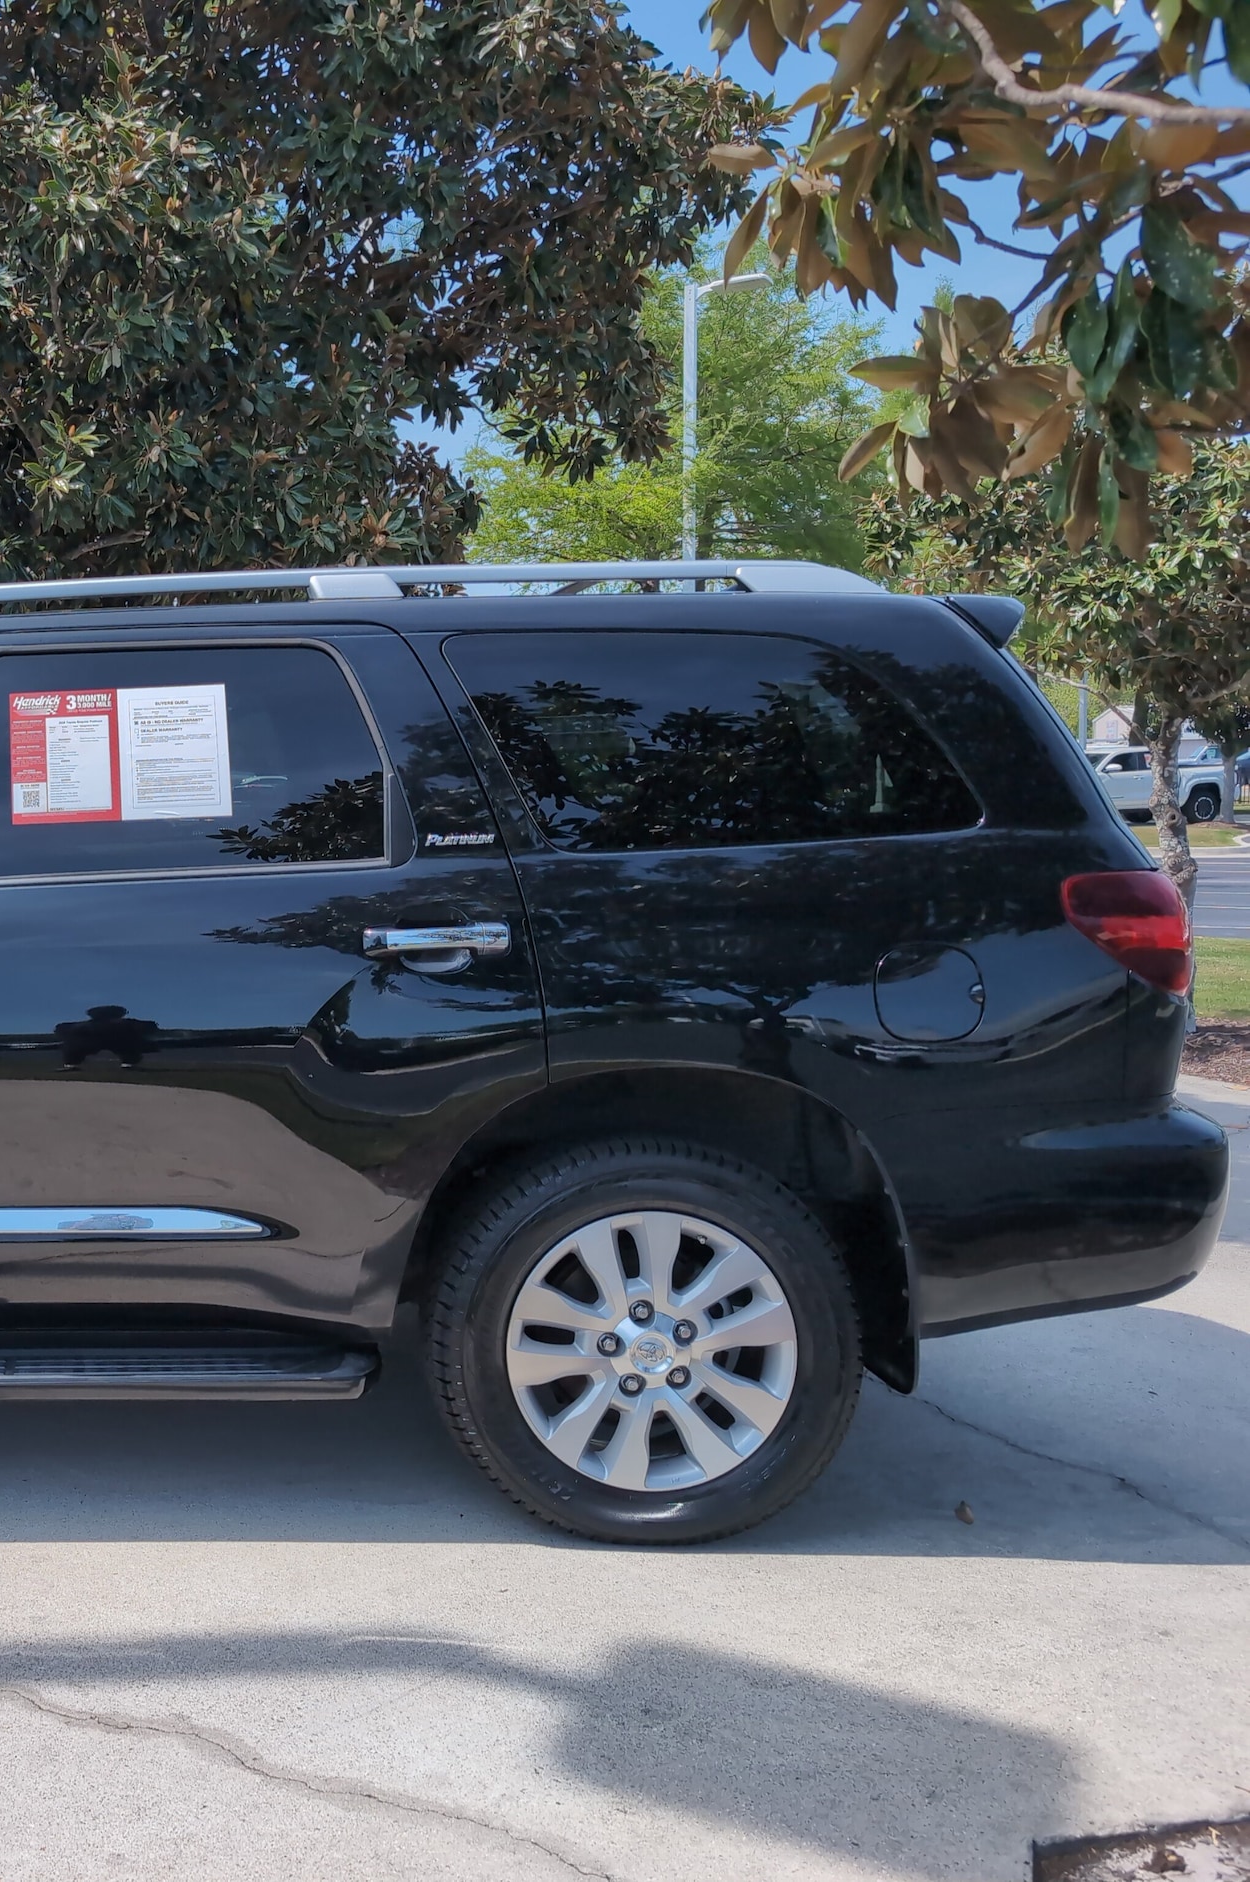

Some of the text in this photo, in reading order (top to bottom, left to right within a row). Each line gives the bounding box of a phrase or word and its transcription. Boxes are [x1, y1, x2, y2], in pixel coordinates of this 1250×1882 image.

[66, 694, 77, 710] 3
[77, 693, 112, 703] MONTH/
[424, 832, 495, 847] PLATINUM
